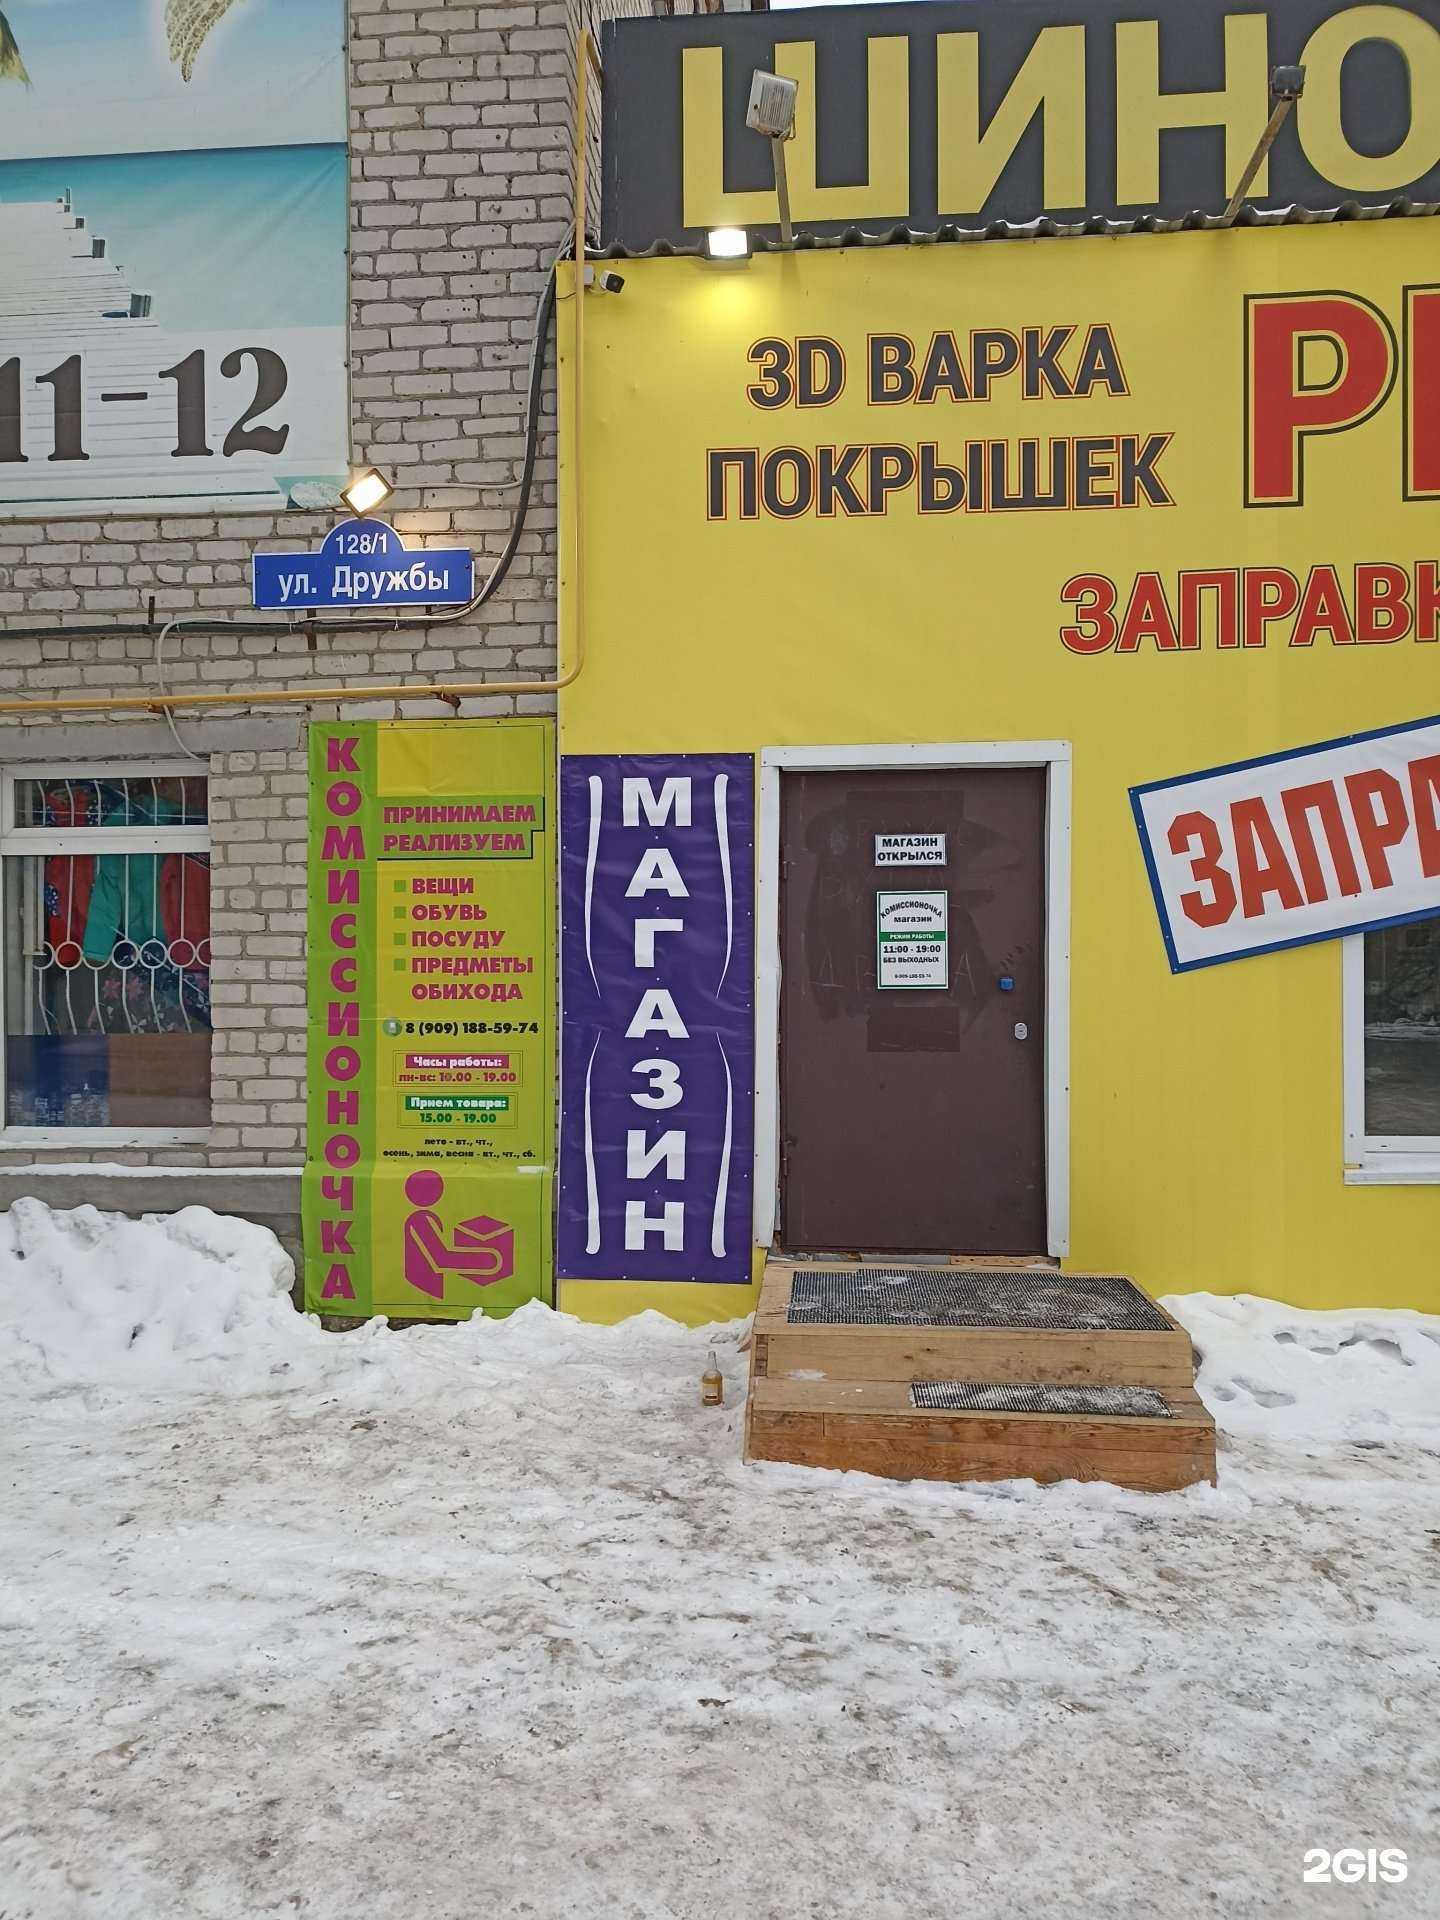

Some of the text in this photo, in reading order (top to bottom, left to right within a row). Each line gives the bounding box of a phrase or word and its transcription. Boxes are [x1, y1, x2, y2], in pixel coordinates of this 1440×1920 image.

[682, 4, 1440, 228] ШИНО
[747, 323, 1131, 410] 3D ВАРКА
[706, 432, 1177, 521] ПОКРЫШЕК
[335, 532, 387, 554] 128/1
[278, 561, 449, 602] ул. Дружбы
[383, 805, 536, 823] ПРИНИМАЕМ
[383, 834, 526, 852] РЕАЛИЗУЕМ
[882, 837, 938, 848] МАГАЗИН
[877, 851, 943, 861] ОТКРЫЛСЯ
[412, 878, 474, 896] ВЕЩИ
[411, 905, 488, 921] ОБУВЬ
[880, 900, 943, 919] КОМИССИОНОЧКА
[894, 915, 933, 923] магазин
[411, 931, 506, 949] ПОСУДУ
[883, 945, 909, 954] 11:00
[915, 944, 941, 953] 19:00
[411, 957, 534, 976] ПРЕДМЕТЫ
[411, 984, 523, 1002] ОБИХОДА
[320, 737, 366, 1300] КОМИССИОНОЧКА
[622, 777, 692, 1252] МАГАЗИН
[405, 1021, 539, 1036] 8 (909) 188-59-74
[413, 1056, 502, 1070] Часы работы:
[399, 1073, 436, 1082] пн-вс:
[483, 1071, 517, 1082] 19.00
[410, 1097, 506, 1110] Прием товара:
[420, 1113, 453, 1123] 15.00
[463, 1113, 497, 1124] 19.00
[424, 1138, 448, 1146] лето
